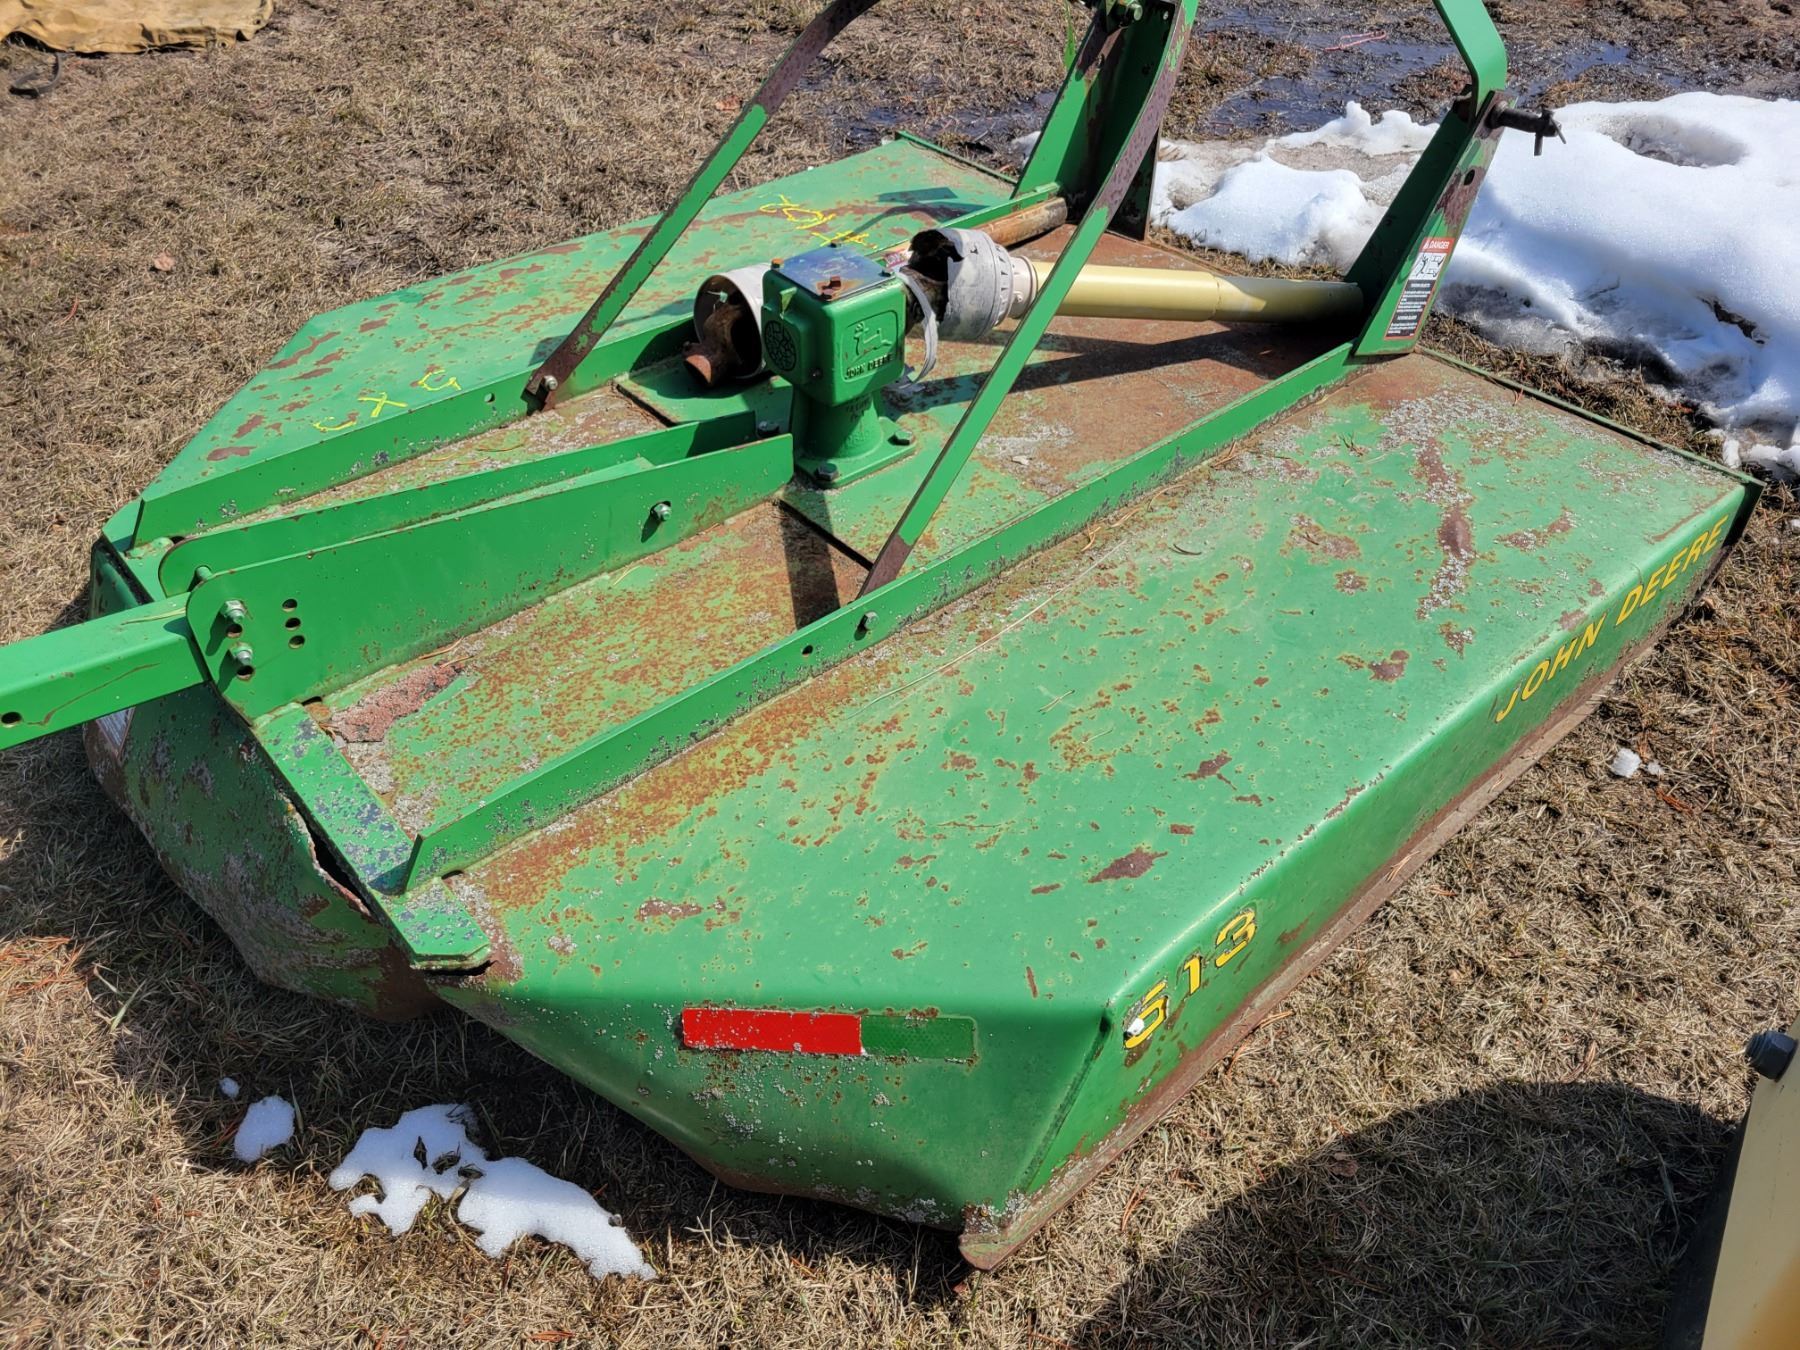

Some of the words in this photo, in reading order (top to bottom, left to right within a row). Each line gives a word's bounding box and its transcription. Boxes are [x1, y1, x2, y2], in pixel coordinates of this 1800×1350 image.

[1429, 241, 1450, 249] DANGER
[867, 353, 893, 371] DEERE
[1495, 611, 1609, 723] JOHN
[1615, 515, 1728, 626] DEERE
[1123, 908, 1258, 1050] 513
